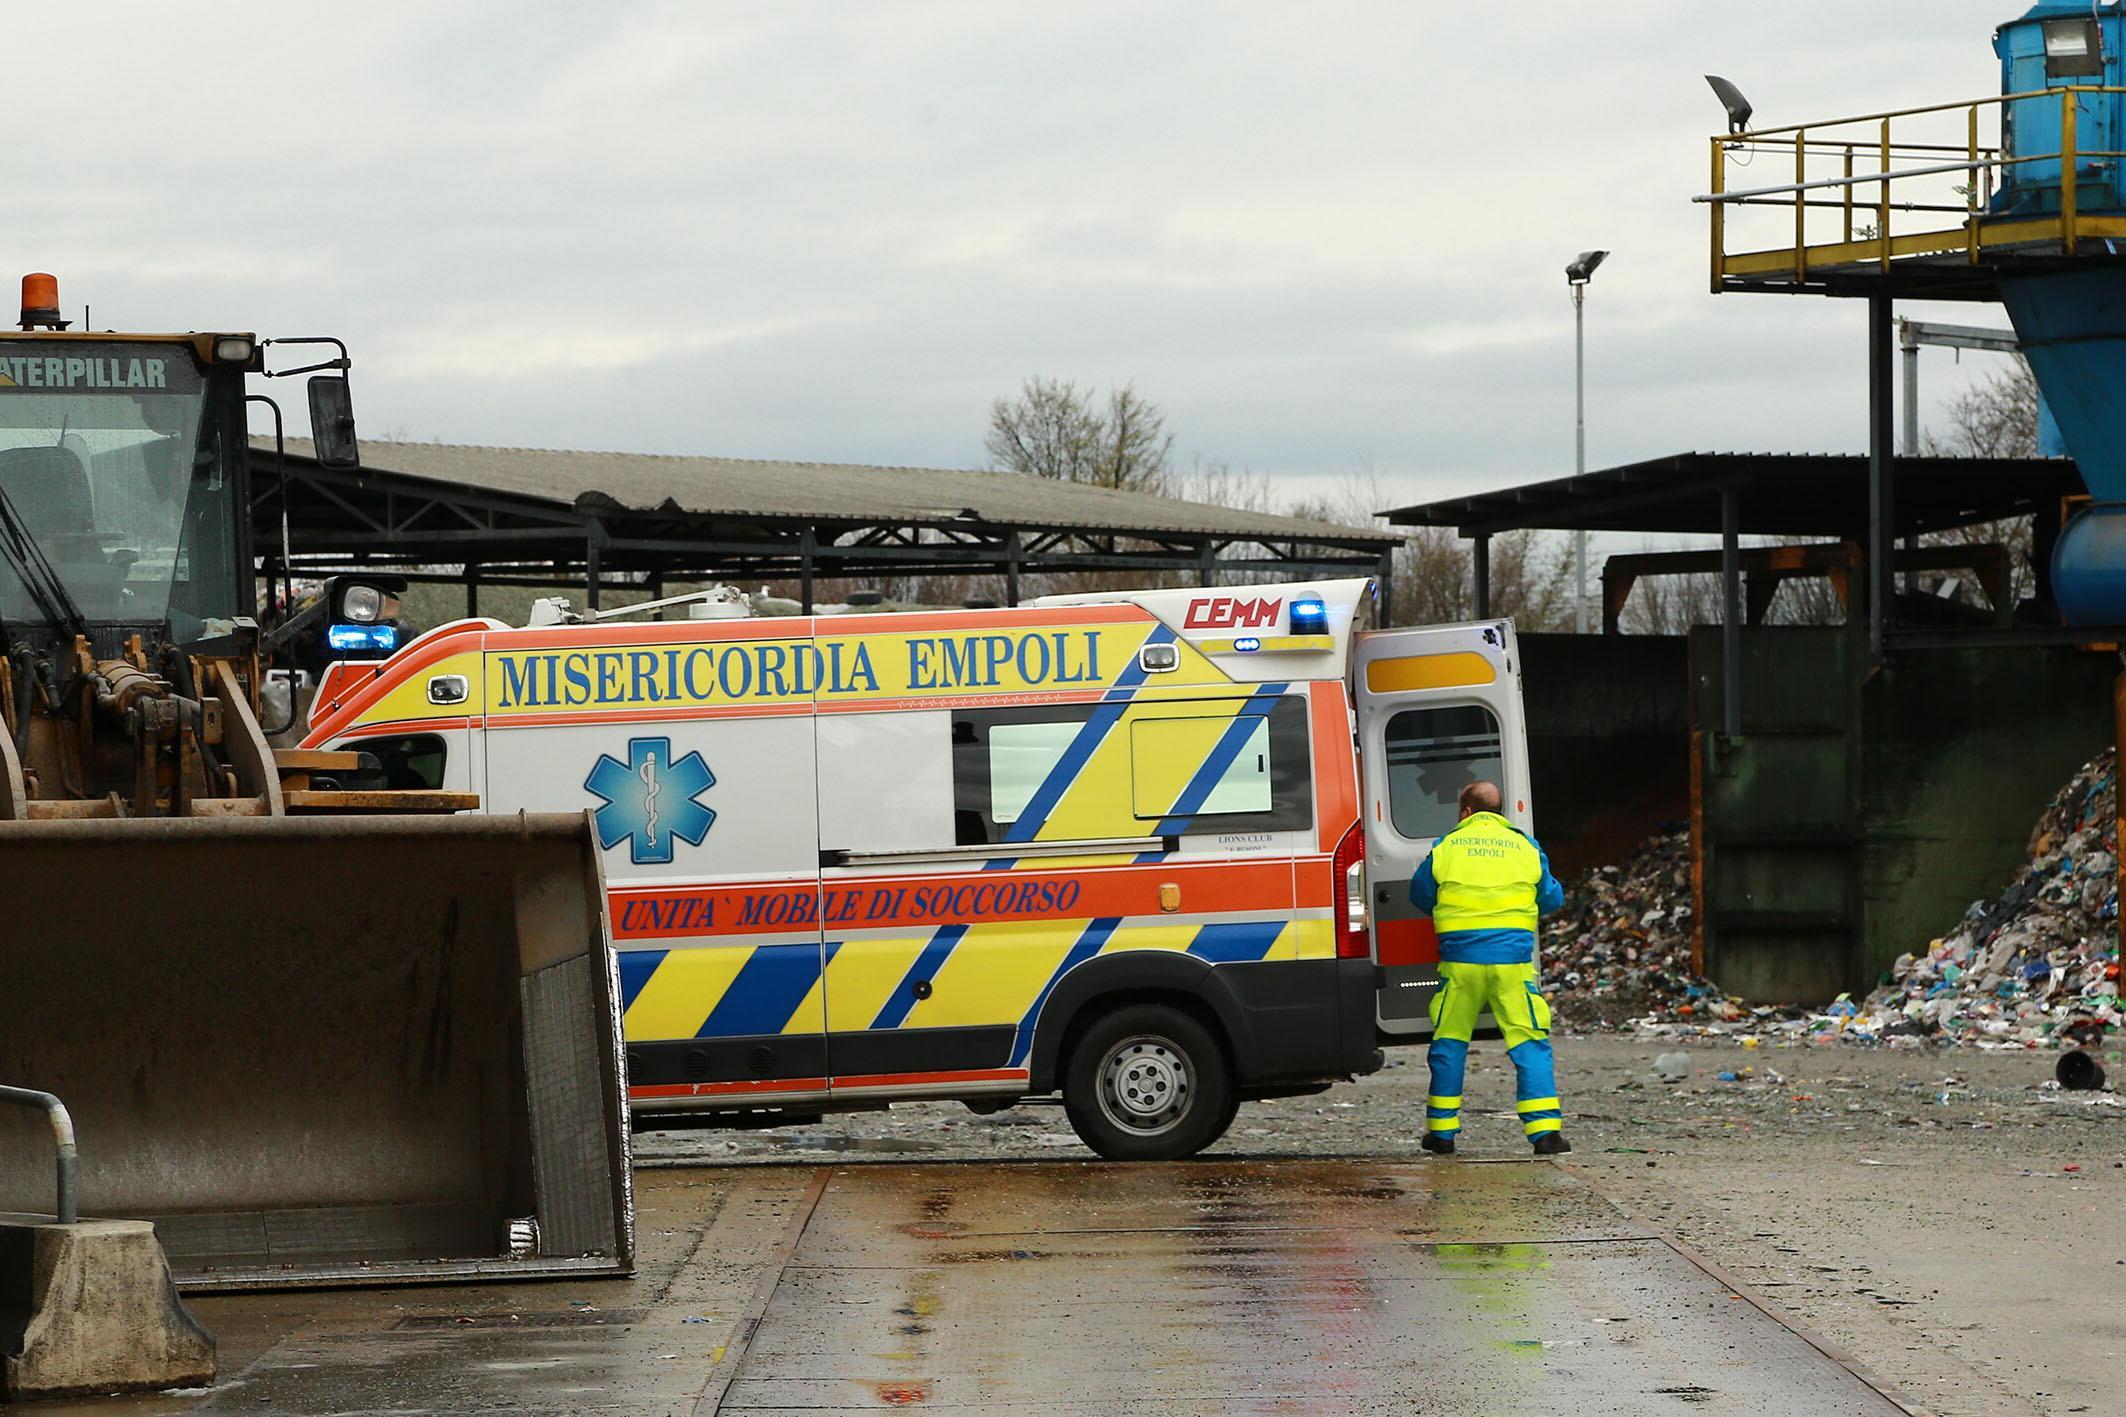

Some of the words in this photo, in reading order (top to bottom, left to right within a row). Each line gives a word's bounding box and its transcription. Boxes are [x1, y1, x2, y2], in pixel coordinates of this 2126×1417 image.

[1184, 596, 1284, 629] CEMM
[498, 641, 880, 708] MISERICORDIA
[905, 631, 1102, 690] EMPOLI
[1218, 834, 1247, 844] LIONS
[1247, 833, 1272, 843] CLUB
[1451, 837, 1521, 850] MISERICORDIA
[1467, 848, 1505, 858] EMPOLI
[736, 890, 862, 927] MOBILE
[864, 887, 910, 921] DI
[909, 879, 1081, 919] SOCCORSO
